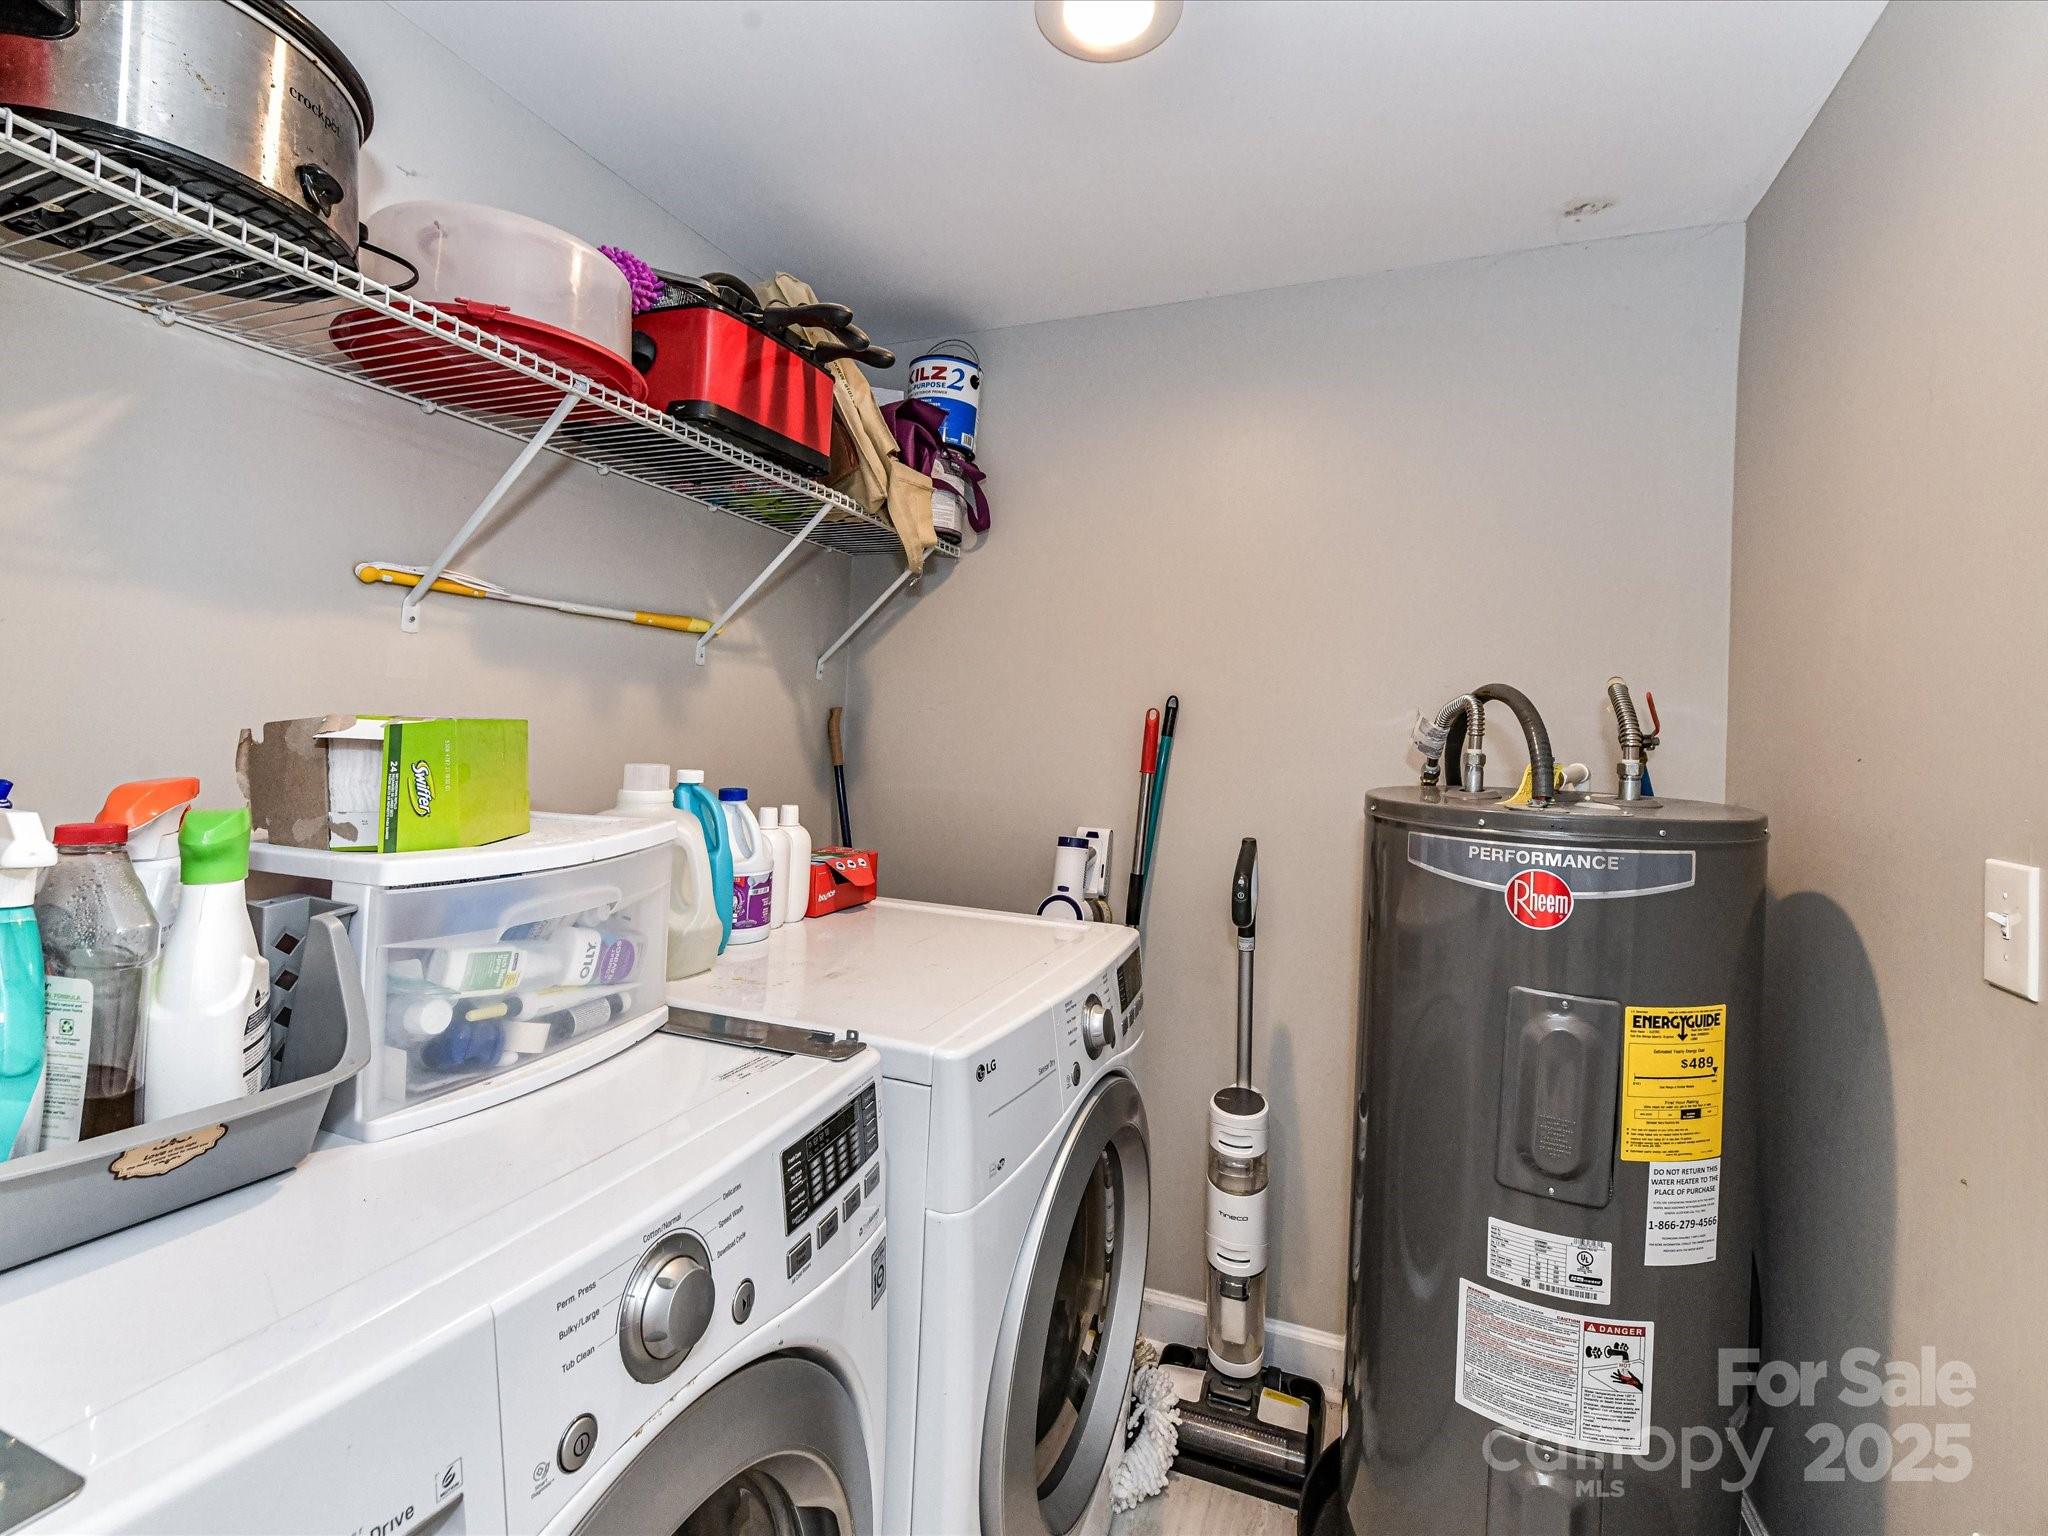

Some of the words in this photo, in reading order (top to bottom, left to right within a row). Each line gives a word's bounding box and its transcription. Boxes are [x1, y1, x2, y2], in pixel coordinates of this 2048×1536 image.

[946, 368, 966, 391] 2
[390, 761, 398, 773] 24
[411, 763, 431, 815] Swiffer
[1468, 845, 1620, 870] PERFORMANCE
[1513, 871, 1569, 920] Rheem
[579, 942, 597, 979] OLLY
[1632, 1013, 1720, 1030] ENERGYGUIDE
[986, 1059, 997, 1074] LG
[1681, 1056, 1714, 1069] $489
[1651, 1178, 1675, 1186] WATER
[1676, 1177, 1700, 1185] HEATER
[1709, 1174, 1719, 1182] THE
[1653, 1168, 1665, 1176] DO
[1665, 1168, 1680, 1176] NOT
[1681, 1167, 1706, 1175] RETURN
[1654, 1188, 1675, 1196] PLACE
[1676, 1188, 1686, 1196] OF
[1686, 1185, 1716, 1195] PURCHASE
[642, 1212, 682, 1244] Cotton/Normal
[1648, 1215, 1717, 1230] 1-866-279-4566
[1580, 1254, 1590, 1264] UL
[556, 1295, 576, 1312] Perm.
[577, 1280, 597, 1298] Press
[558, 1308, 600, 1341] Bulky/Large
[1599, 1325, 1643, 1336] DANGER
[561, 1359, 576, 1374] Tub
[576, 1345, 596, 1363] Clean
